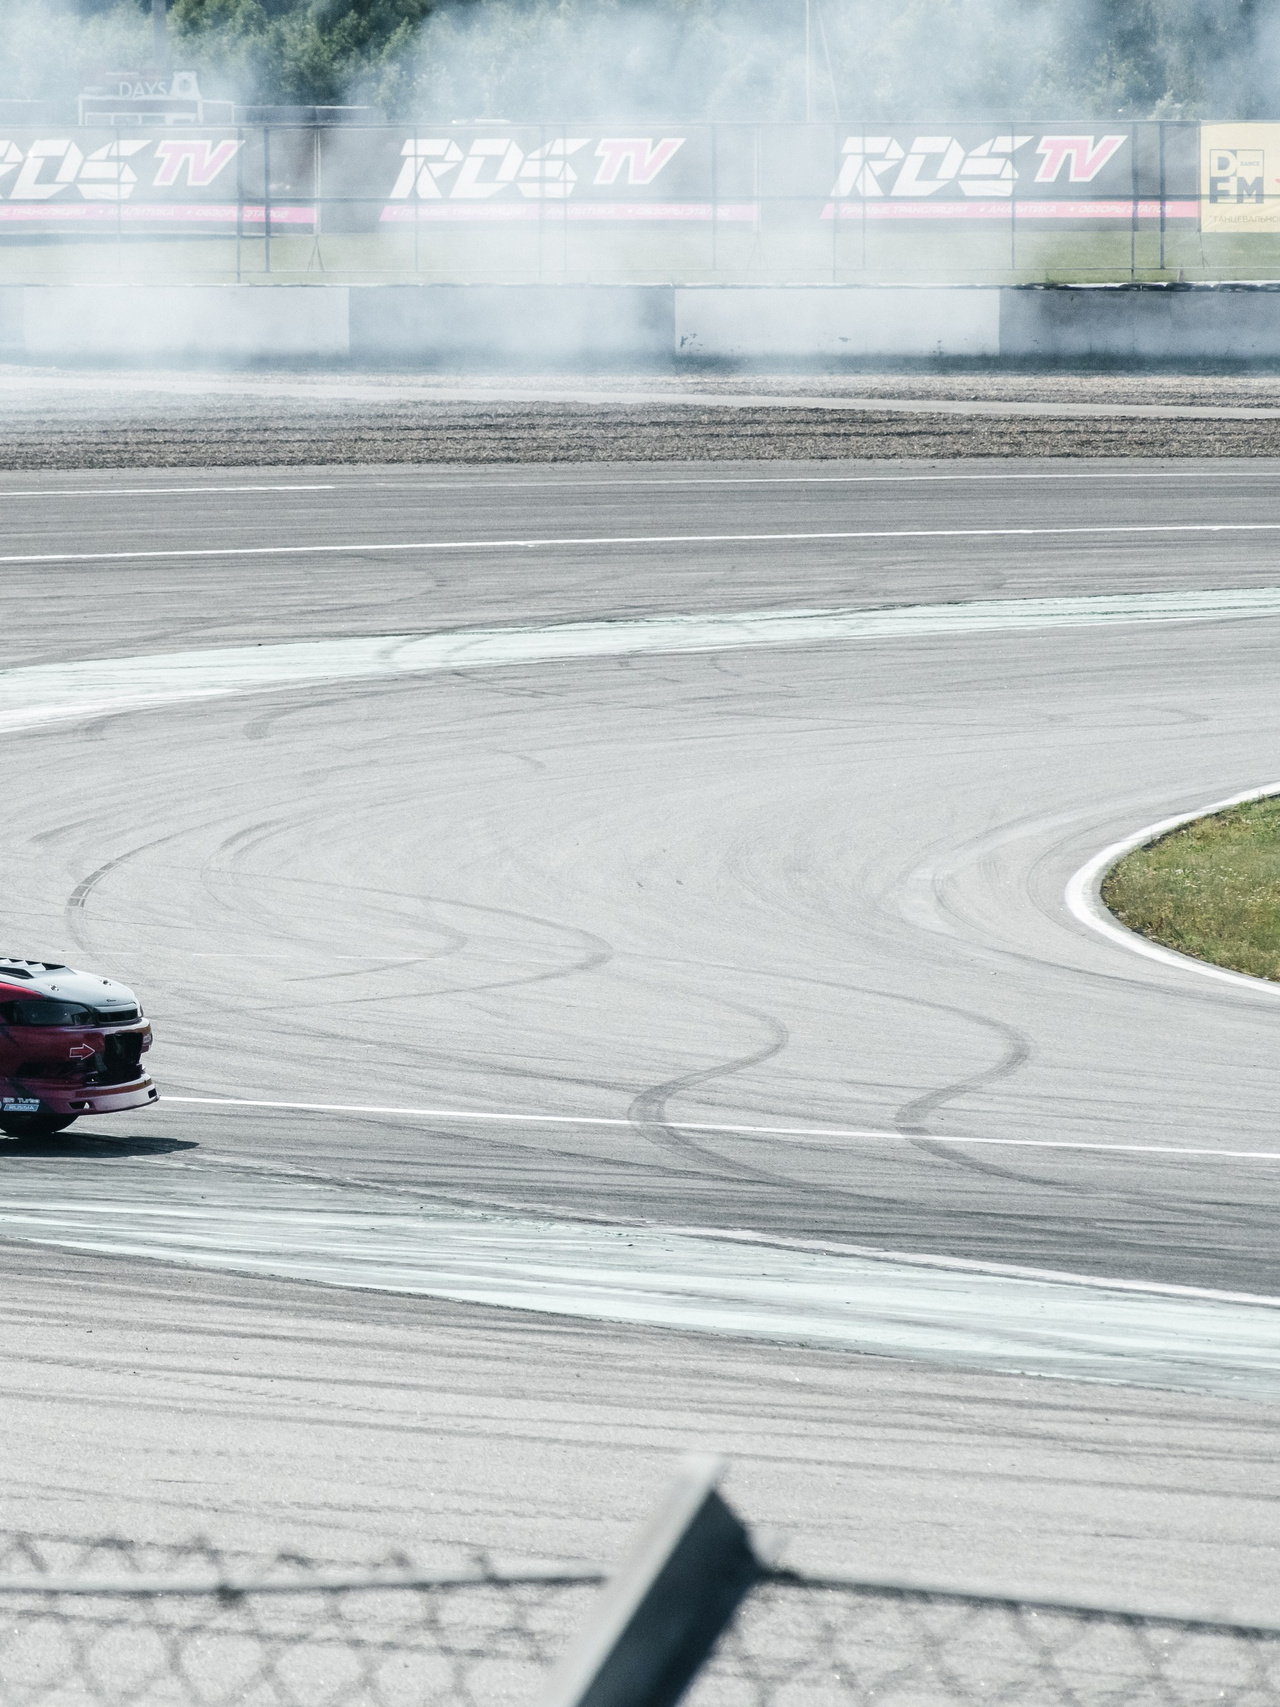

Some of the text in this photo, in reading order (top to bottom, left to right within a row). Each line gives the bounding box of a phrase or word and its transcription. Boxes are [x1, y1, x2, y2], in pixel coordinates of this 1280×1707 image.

[153, 139, 246, 187] TV
[389, 137, 687, 199] RDS TV
[830, 134, 1129, 197] RDS TV
